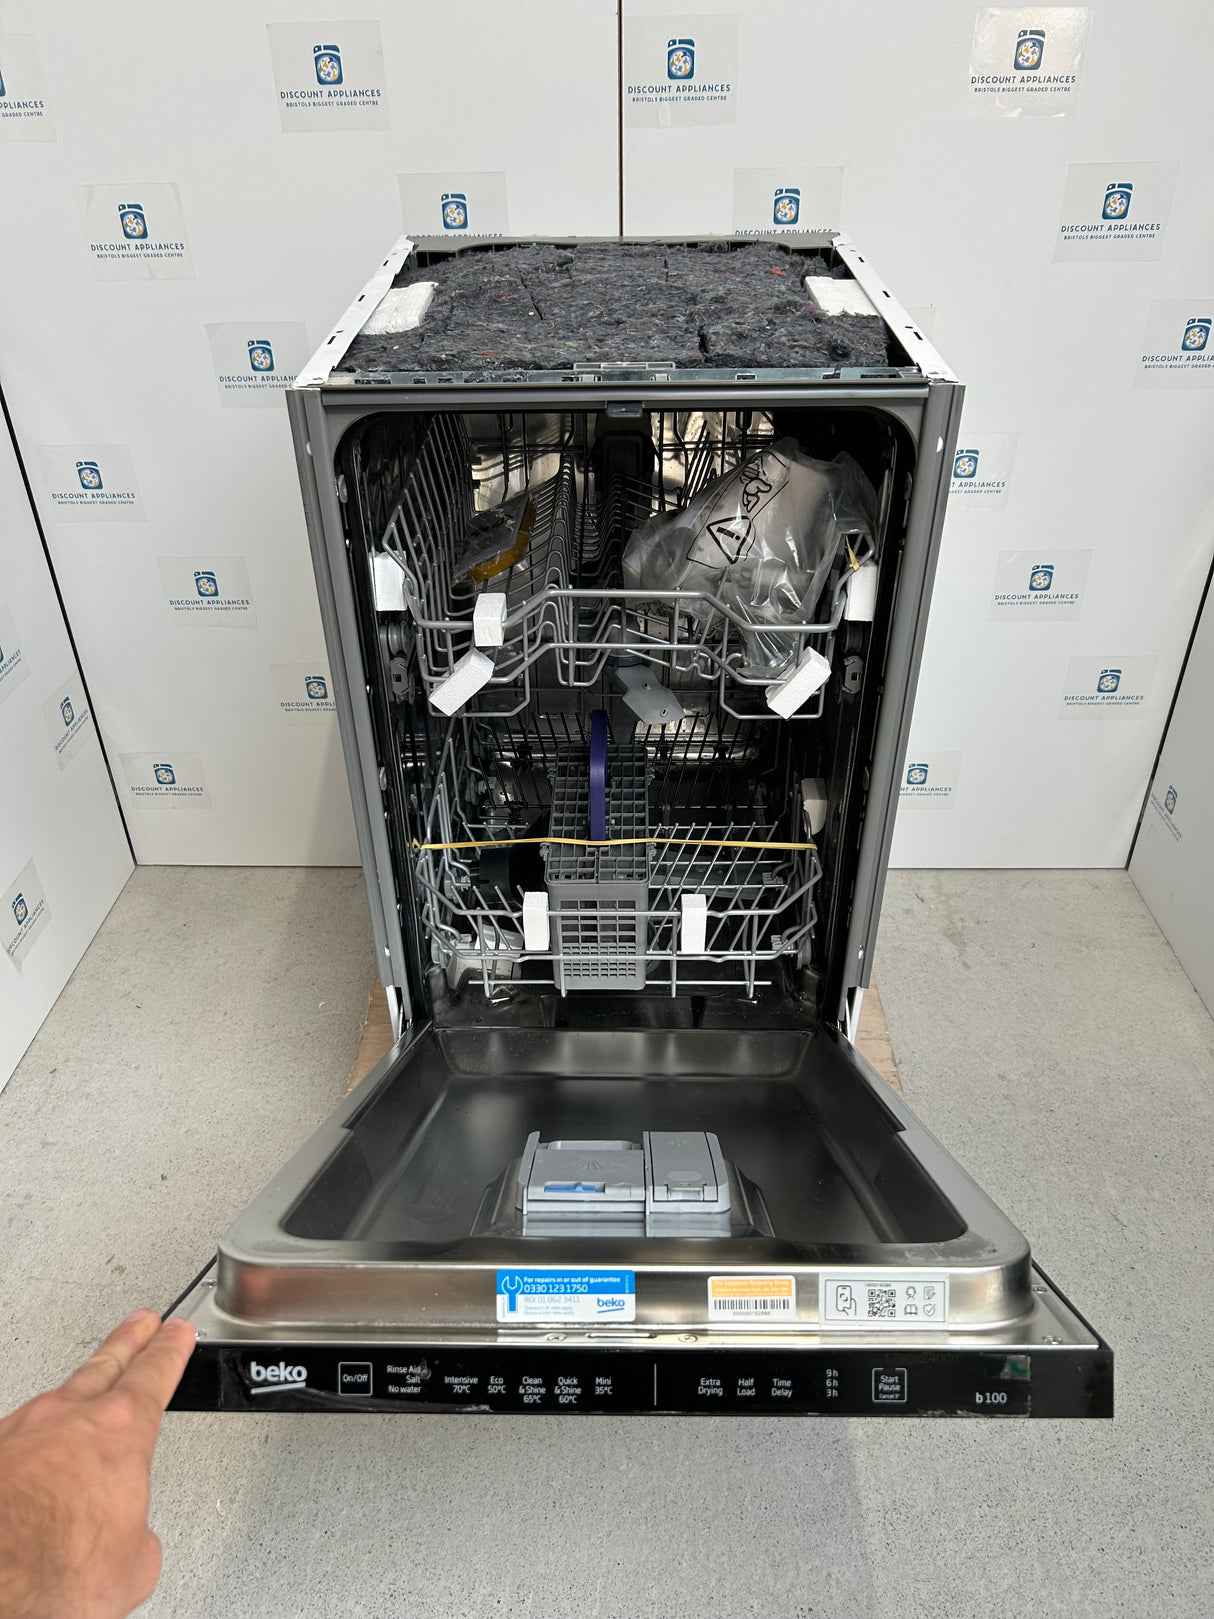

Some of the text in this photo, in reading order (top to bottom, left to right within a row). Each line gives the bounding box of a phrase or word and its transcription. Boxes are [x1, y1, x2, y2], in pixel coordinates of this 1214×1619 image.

[628, 84, 730, 94] DISCOUNT APPLIANCES
[328, 90, 381, 98] APPLIANCES
[0, 101, 44, 109] PLIANCES
[524, 1284, 588, 1292] 0330 123 1750
[597, 1298, 625, 1307] beko
[250, 1361, 307, 1381] beko
[387, 1365, 421, 1373] Rinse Aid
[343, 1373, 368, 1382] On/Off
[558, 1377, 578, 1385] Quick
[739, 1378, 754, 1386] Half
[773, 1378, 791, 1386] Time
[698, 1386, 723, 1396] Drying
[737, 1388, 755, 1396] Load
[771, 1388, 792, 1397] Delay
